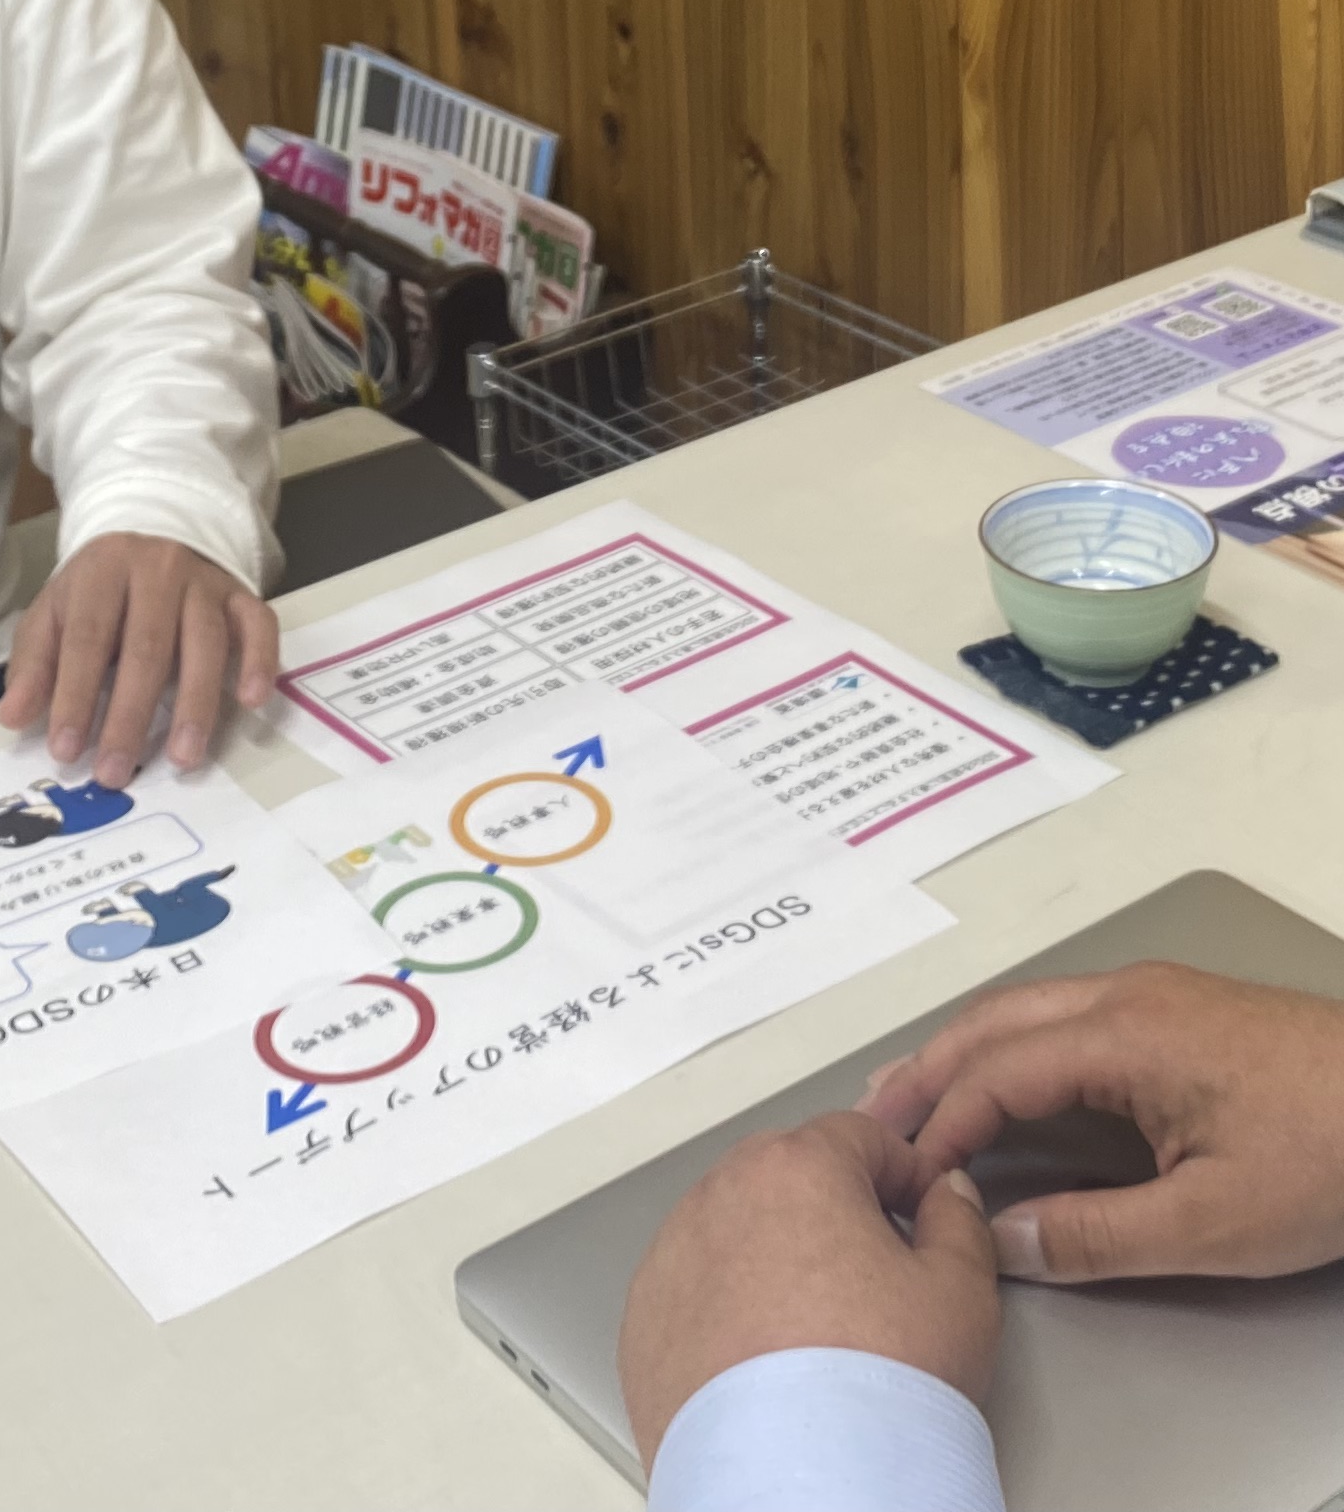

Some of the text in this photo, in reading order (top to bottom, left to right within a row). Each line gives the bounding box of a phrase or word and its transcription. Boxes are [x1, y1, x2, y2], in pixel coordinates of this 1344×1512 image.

[587, 607, 725, 671] 若手の人材採用
[411, 673, 498, 715] 資金調達
[724, 699, 879, 772] 新たな事業機会のチ
[477, 792, 579, 842] 人事戦略
[396, 893, 505, 948] 事業戦略
[188, 892, 815, 1208] SDGsによる経営のアップデート
[285, 996, 404, 1057] 経営戦略
